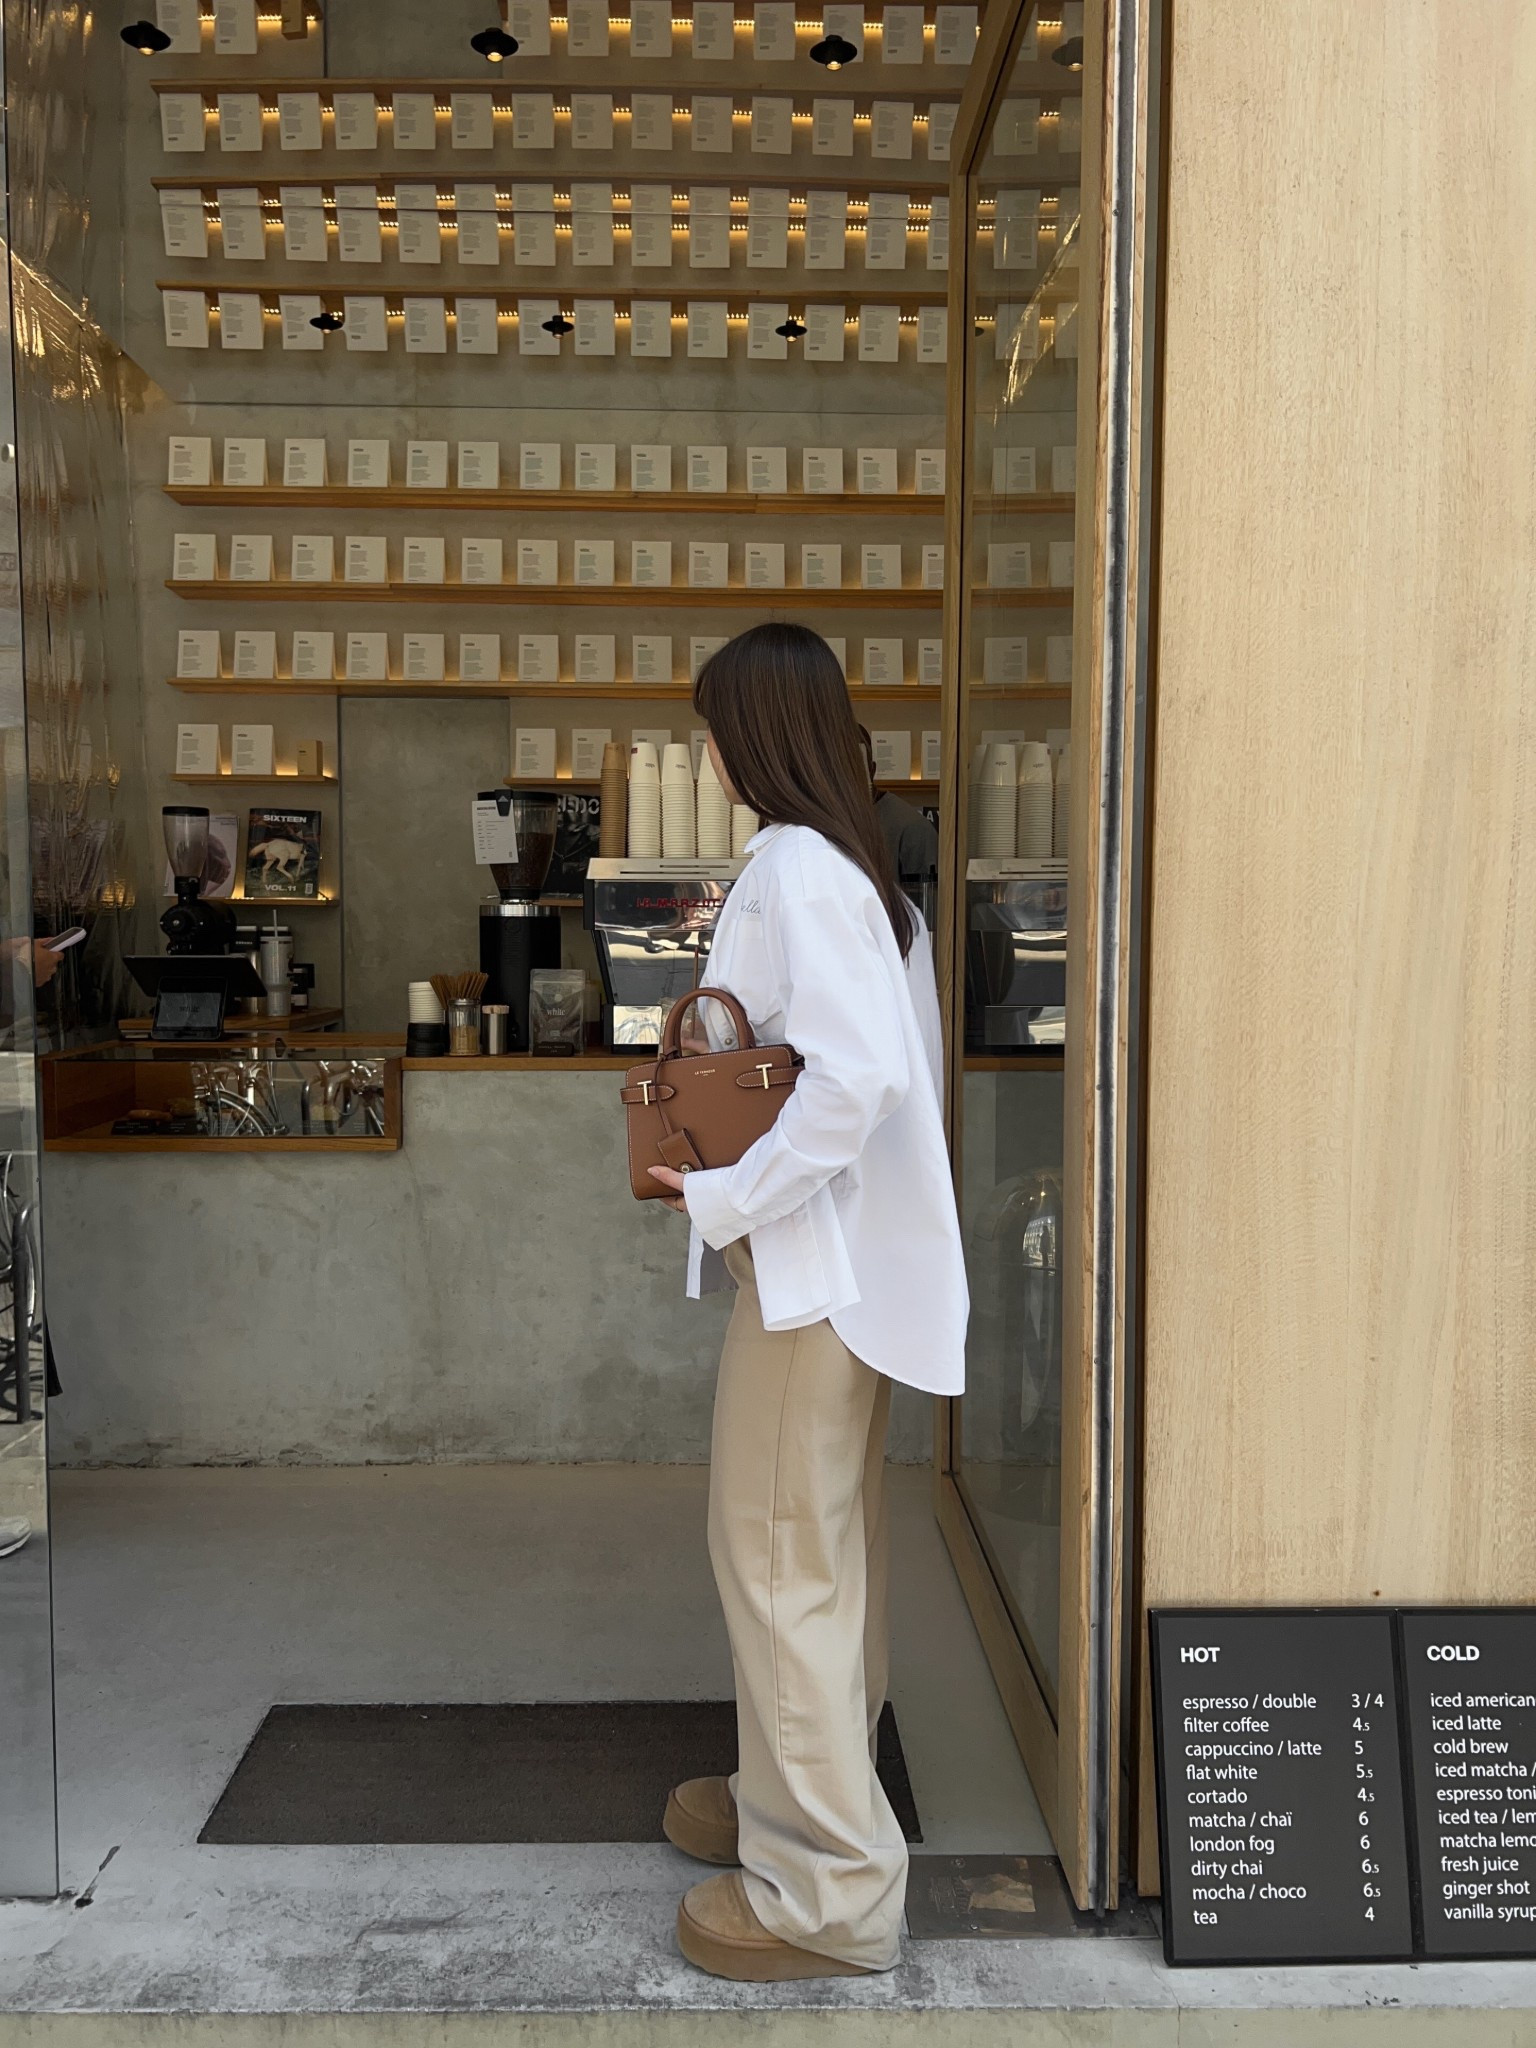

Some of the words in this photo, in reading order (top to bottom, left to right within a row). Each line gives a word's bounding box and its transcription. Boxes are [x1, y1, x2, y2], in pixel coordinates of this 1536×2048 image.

[263, 814, 307, 823] SIXTEEN
[1180, 1646, 1221, 1663] HOT
[1426, 1645, 1480, 1662] COLD
[1182, 1697, 1249, 1713] espresso
[1252, 1693, 1259, 1710] /
[1262, 1692, 1317, 1709] double
[1351, 1693, 1361, 1708] 3
[1364, 1692, 1371, 1709] /
[1373, 1693, 1385, 1708] 4
[1430, 1691, 1463, 1708] iced
[1465, 1692, 1536, 1708] american
[1183, 1716, 1220, 1733] filter
[1222, 1716, 1270, 1733] coffee
[1431, 1714, 1464, 1731] iced
[1467, 1714, 1502, 1731] latte
[1184, 1740, 1274, 1760] cappuccino
[1277, 1740, 1284, 1757] /
[1287, 1739, 1322, 1756] latte
[1354, 1740, 1364, 1755] 5
[1433, 1738, 1467, 1755] cold
[1469, 1737, 1509, 1754] brew
[1185, 1763, 1212, 1780] flat
[1213, 1763, 1258, 1780] white
[1435, 1761, 1467, 1778] iced
[1470, 1760, 1528, 1777] matcha
[1187, 1787, 1248, 1804] cortado
[1436, 1788, 1503, 1805] espresso
[1505, 1784, 1536, 1801] toni
[1188, 1811, 1247, 1828] matcha
[1249, 1811, 1257, 1828] /
[1259, 1810, 1293, 1827] chaï
[1358, 1810, 1369, 1826] 6
[1438, 1808, 1471, 1825] iced
[1473, 1810, 1498, 1825] tea
[1501, 1808, 1509, 1825] /
[1189, 1835, 1246, 1852] london
[1248, 1834, 1275, 1855] fog
[1360, 1834, 1371, 1850] 6
[1439, 1831, 1497, 1848] matcha
[1190, 1859, 1228, 1880] dirty
[1230, 1859, 1263, 1876] chai
[1440, 1855, 1480, 1872] fresh
[1481, 1855, 1520, 1876] juice
[1192, 1883, 1246, 1901] mocha
[1248, 1883, 1256, 1901] /
[1259, 1882, 1307, 1900] choco
[1442, 1880, 1494, 1900] ginger
[1496, 1878, 1531, 1895] shot
[1192, 1909, 1218, 1925] tea
[1364, 1906, 1376, 1922] 4
[1443, 1902, 1494, 1920] vanilla
[1497, 1906, 1536, 1923] syrup
